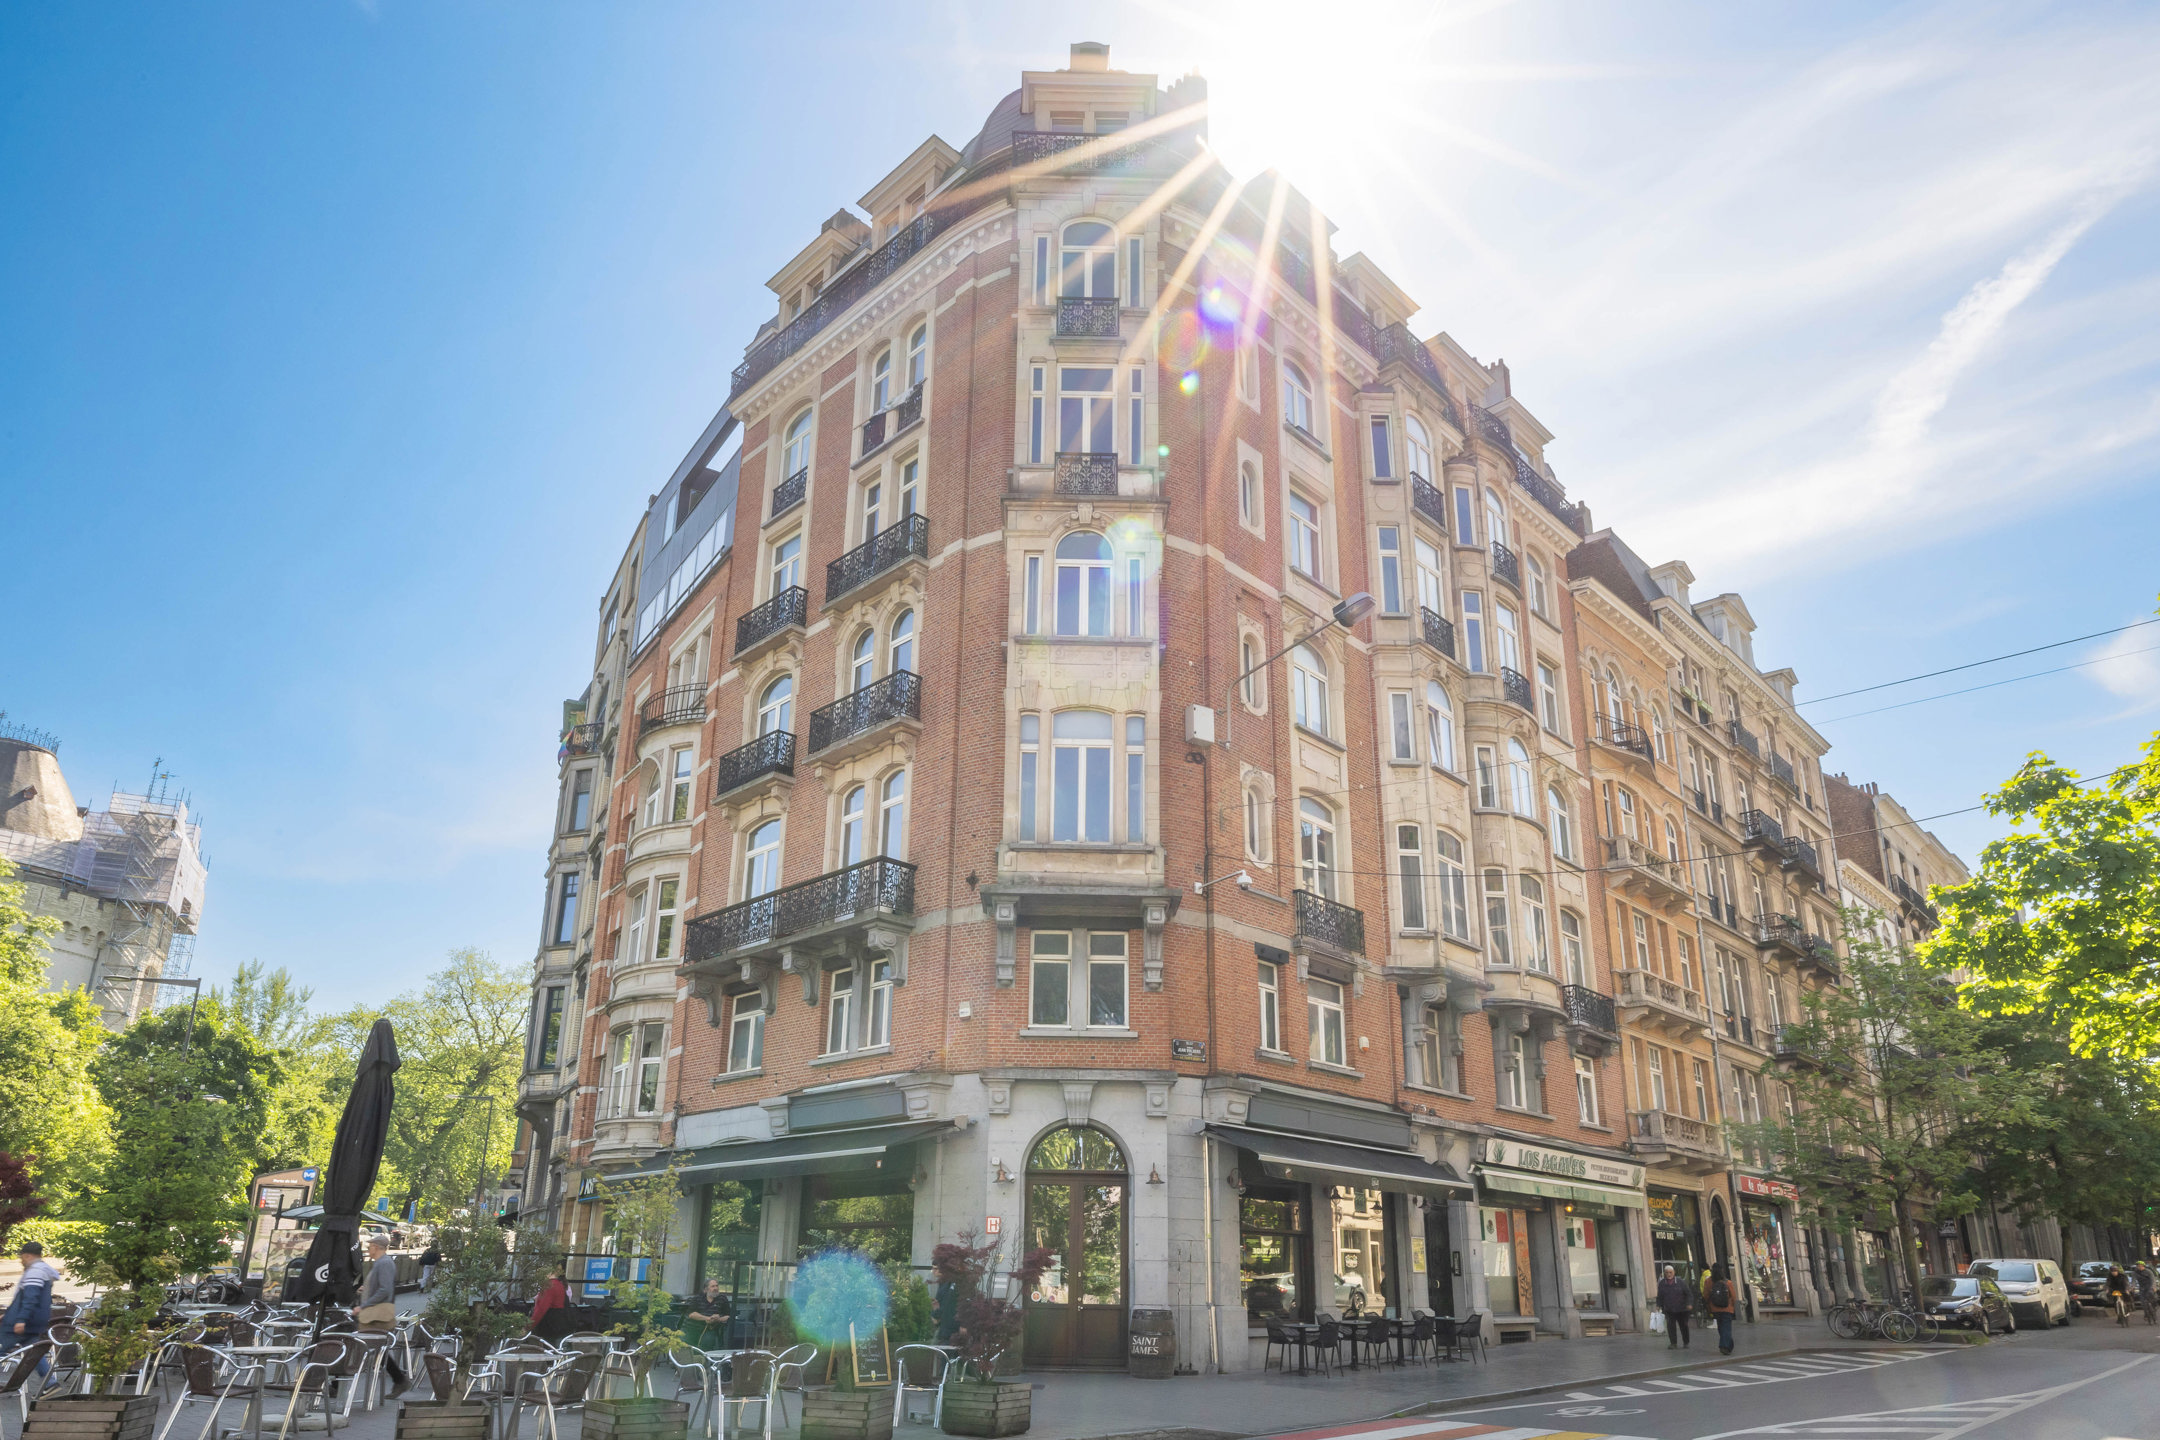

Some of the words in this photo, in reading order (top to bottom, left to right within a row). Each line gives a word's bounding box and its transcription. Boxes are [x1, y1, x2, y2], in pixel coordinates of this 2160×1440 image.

[1518, 1148, 1540, 1169] LOS
[1541, 1153, 1586, 1177] AGAVES
[987, 1217, 1000, 1233] H
[1132, 1335, 1159, 1346] SAINT
[1131, 1345, 1160, 1356] JAMES
